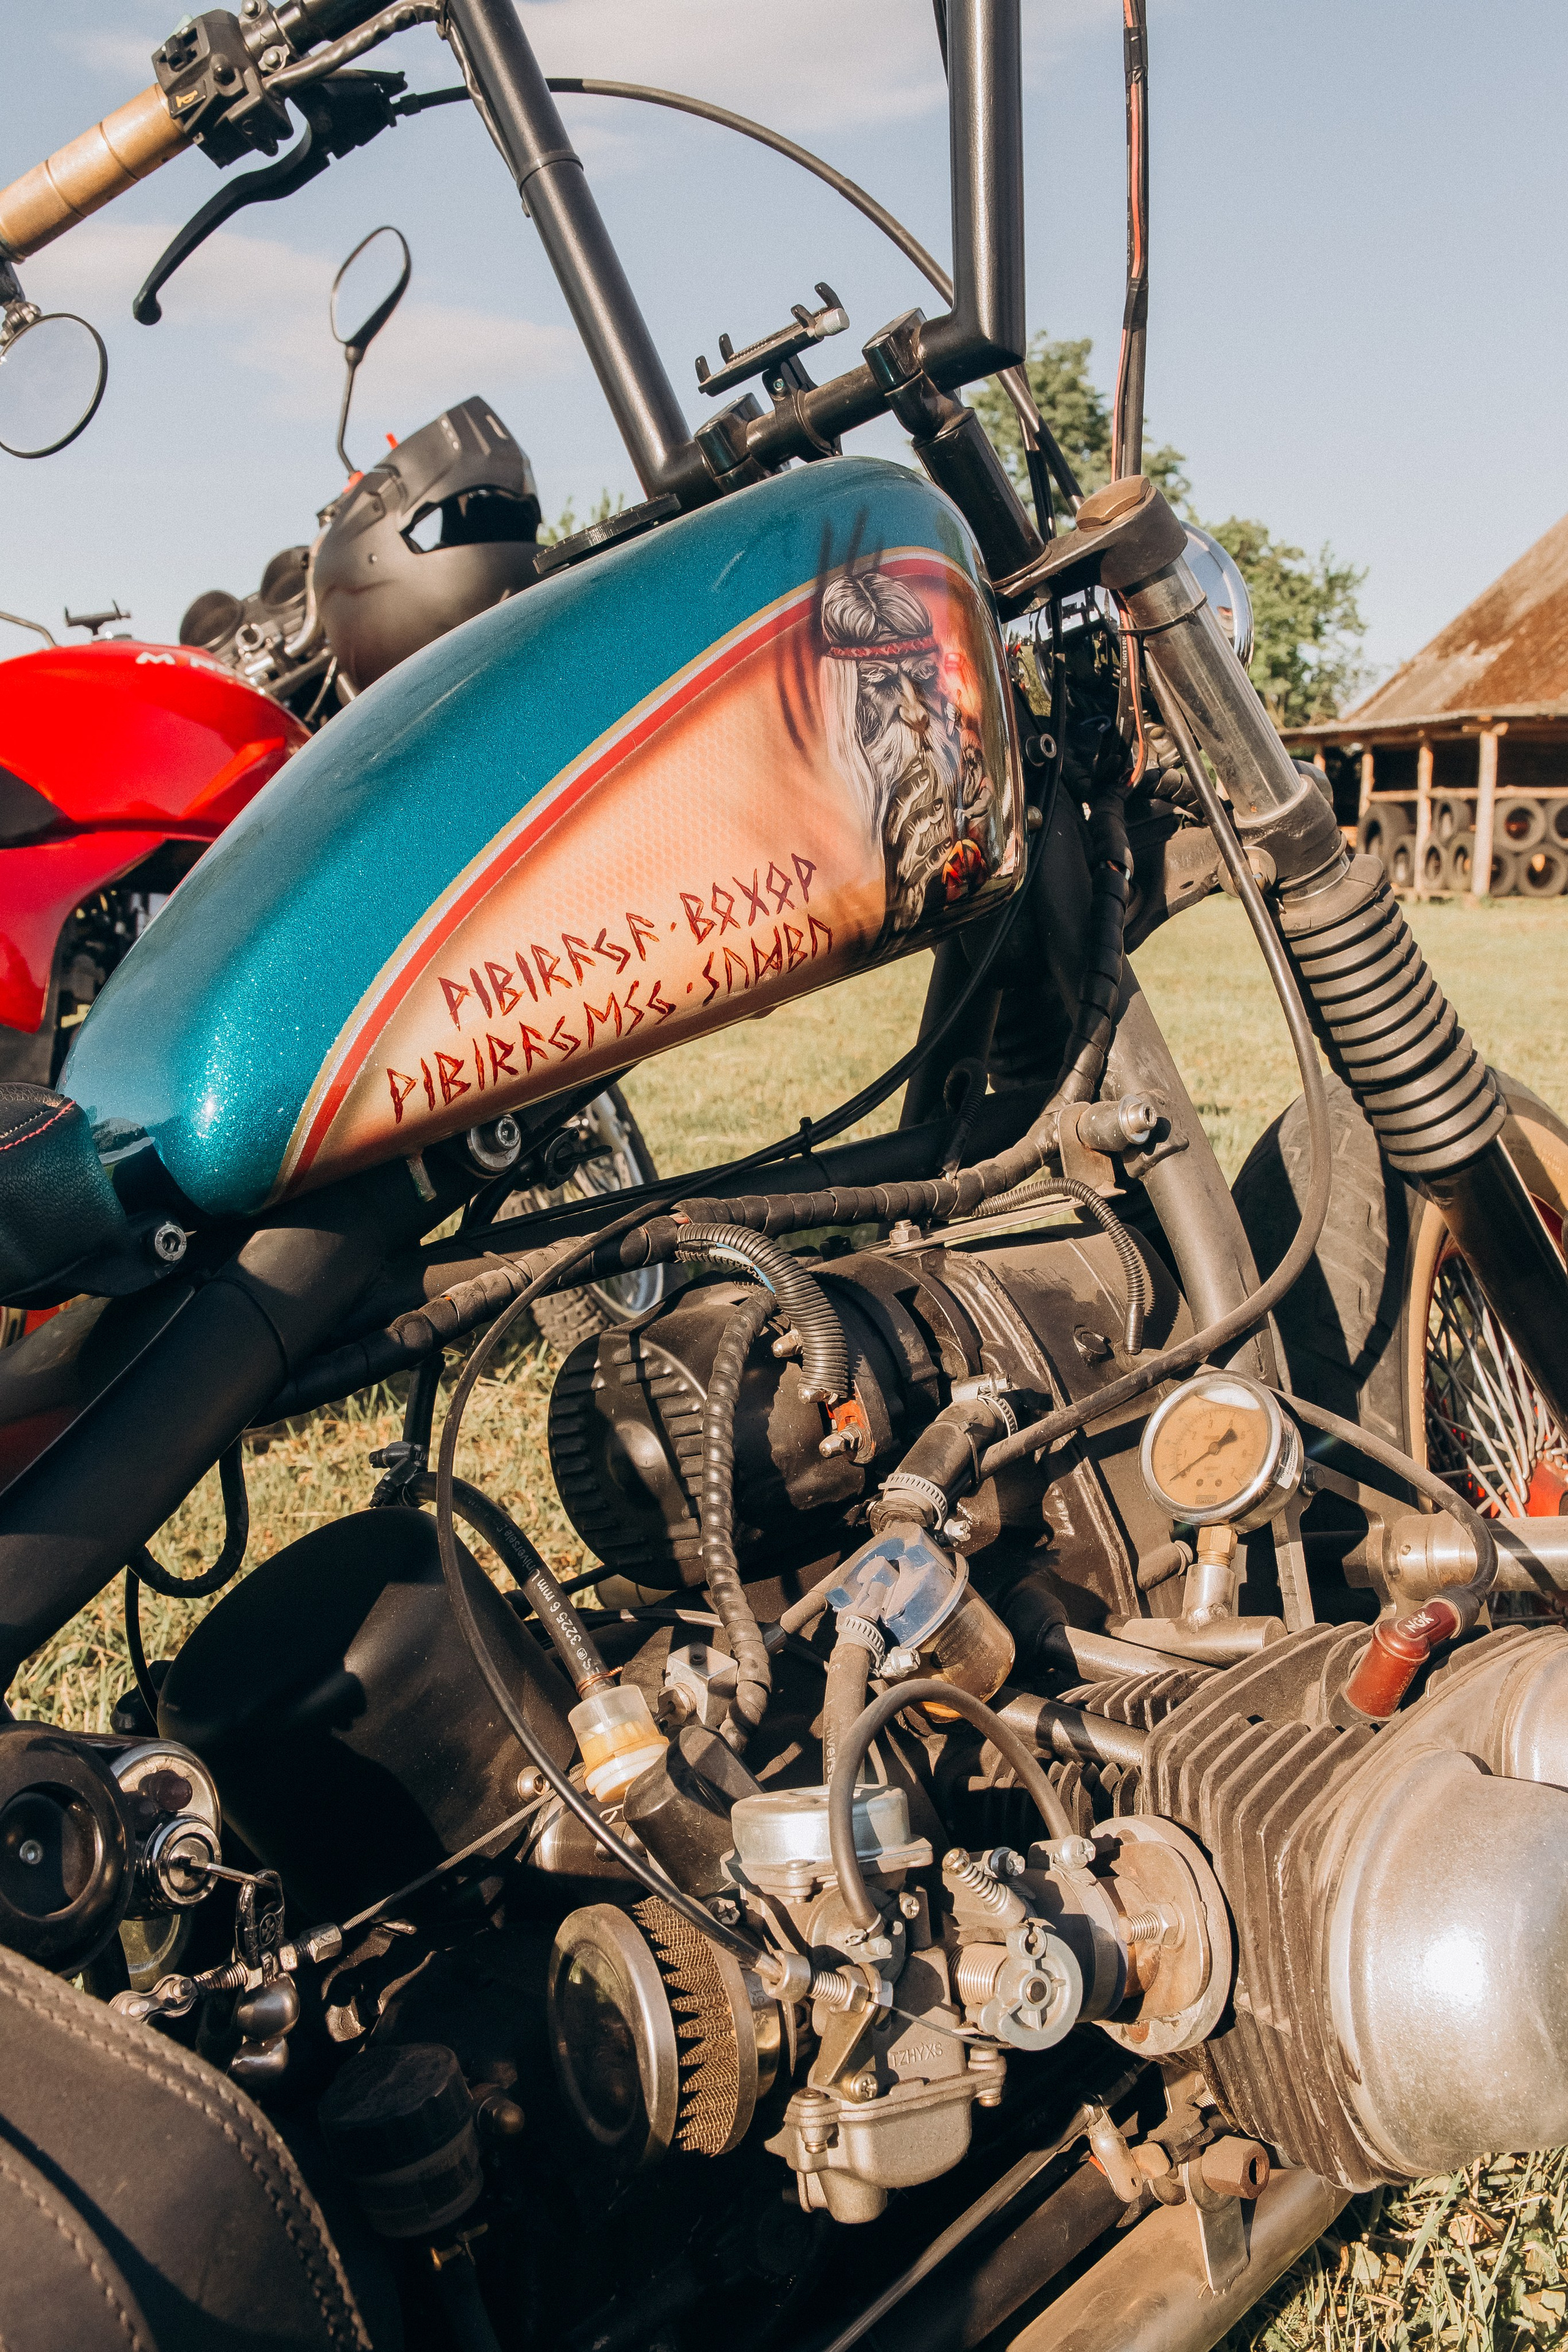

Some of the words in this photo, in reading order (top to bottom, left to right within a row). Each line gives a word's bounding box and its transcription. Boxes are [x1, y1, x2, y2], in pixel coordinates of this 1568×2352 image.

[1208, 1419, 1213, 1428] 3
[537, 1578, 556, 1602] mm
[549, 1601, 561, 1613] 6
[556, 1611, 582, 1646] 3225
[1404, 1611, 1434, 1634] NGK
[889, 2041, 943, 2067] TZHYXS
